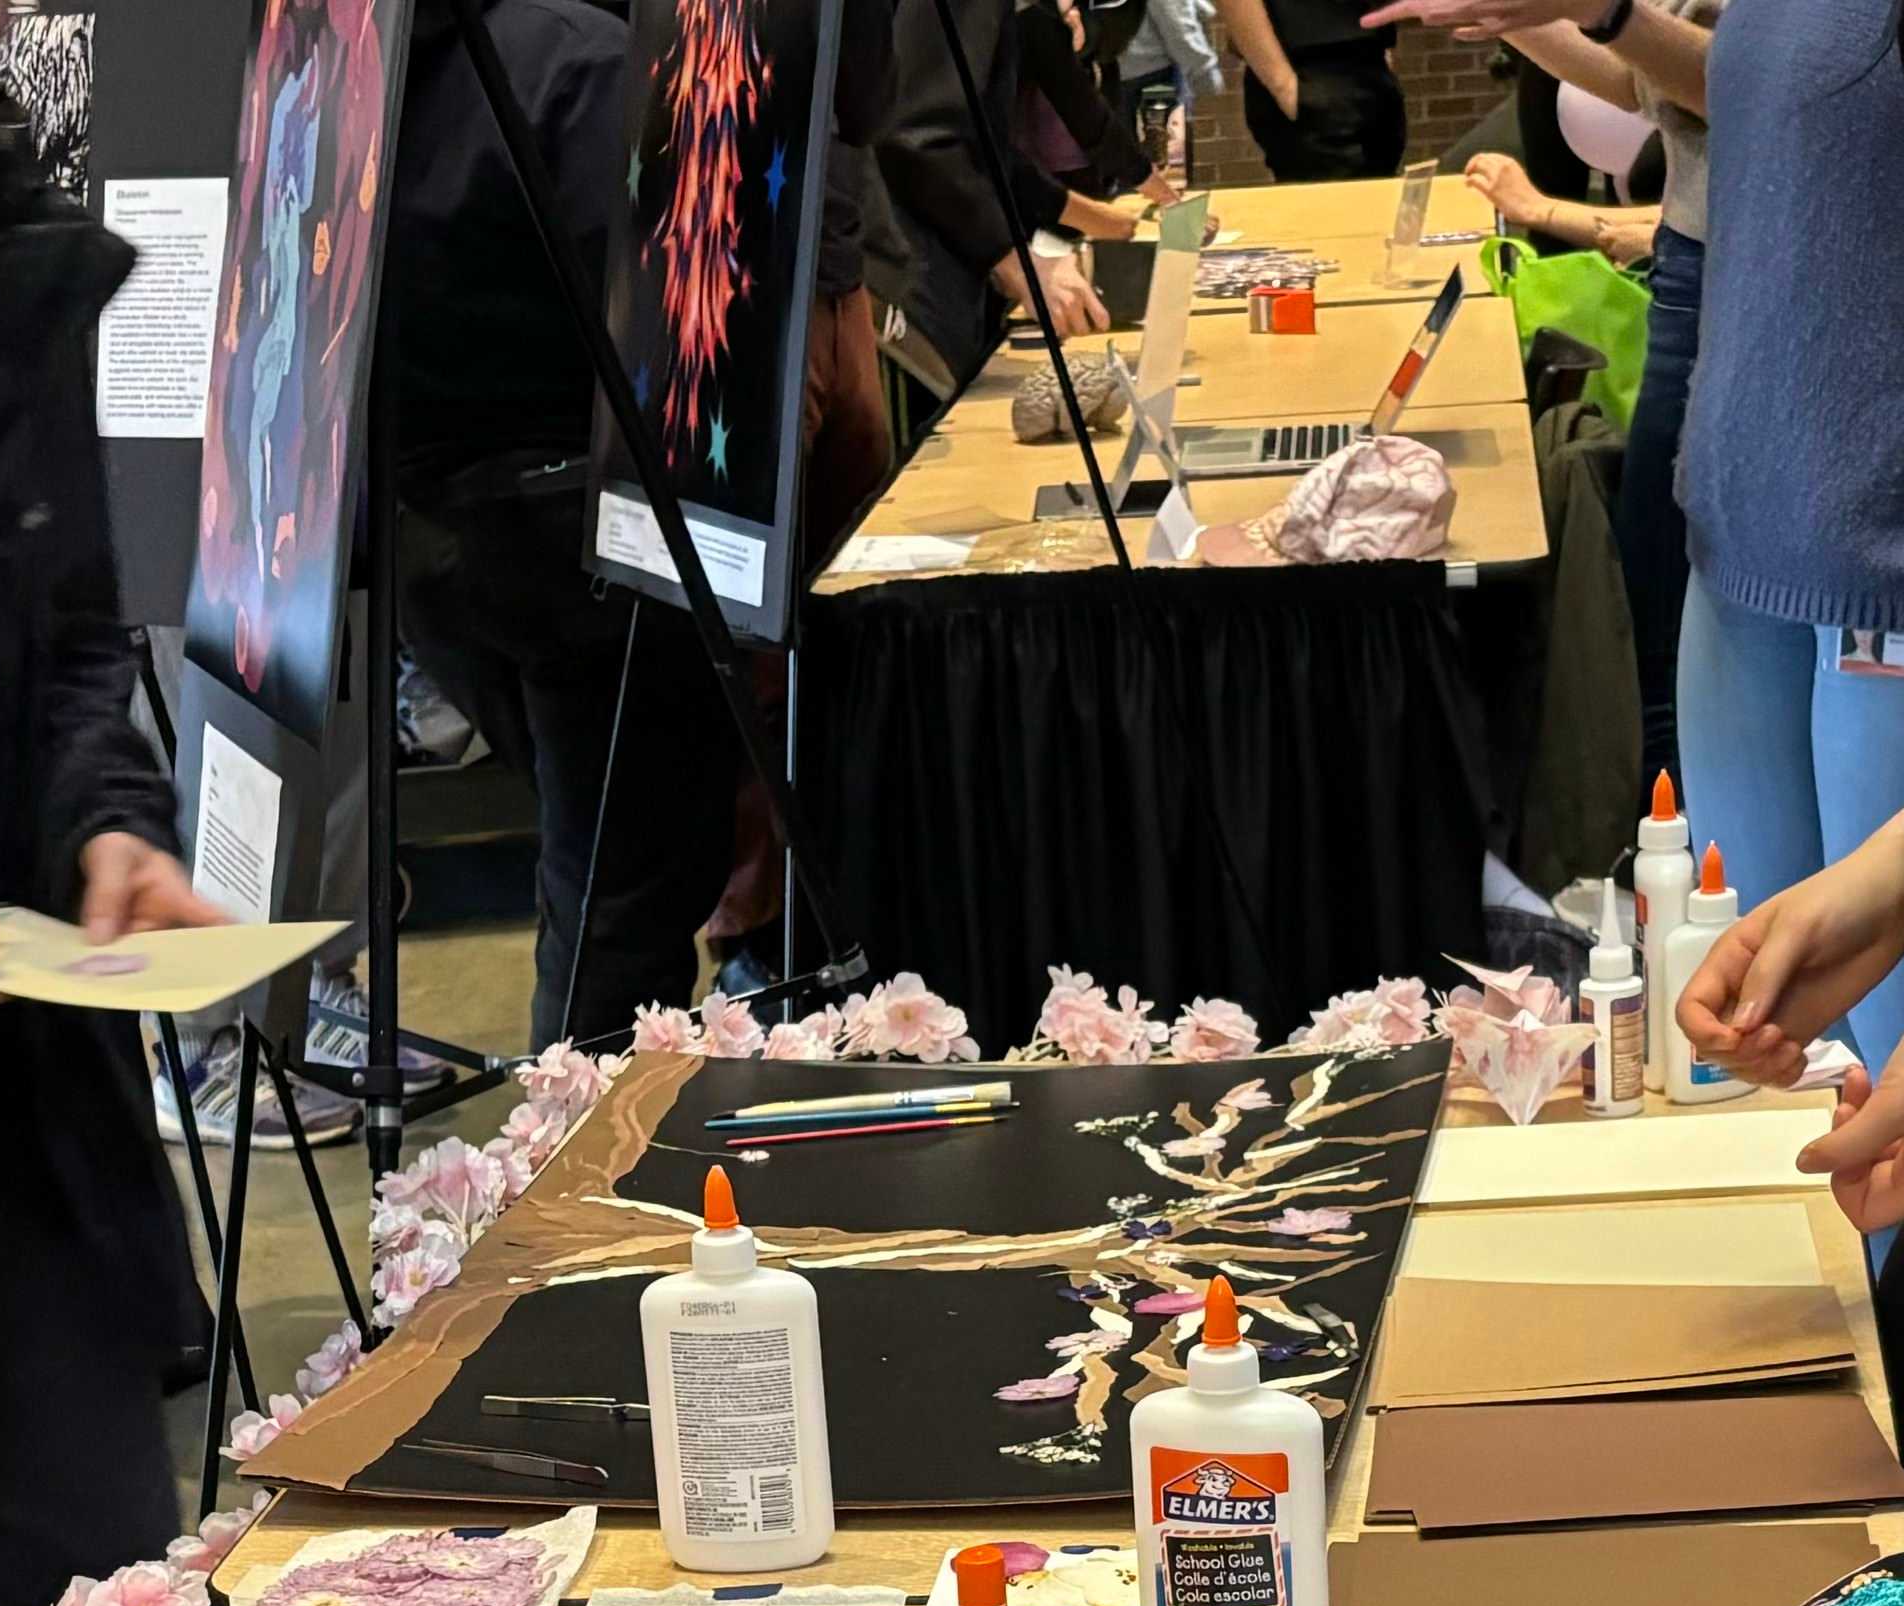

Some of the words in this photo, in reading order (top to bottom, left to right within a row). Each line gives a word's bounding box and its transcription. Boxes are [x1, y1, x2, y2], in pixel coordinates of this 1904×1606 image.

[1169, 1497, 1270, 1520] ELMER'S
[1175, 1553, 1225, 1569] School
[1228, 1553, 1264, 1568] Glue
[1174, 1571, 1210, 1586] Colle
[1176, 1588, 1210, 1602] Cola
[1214, 1585, 1275, 1602] escolar
